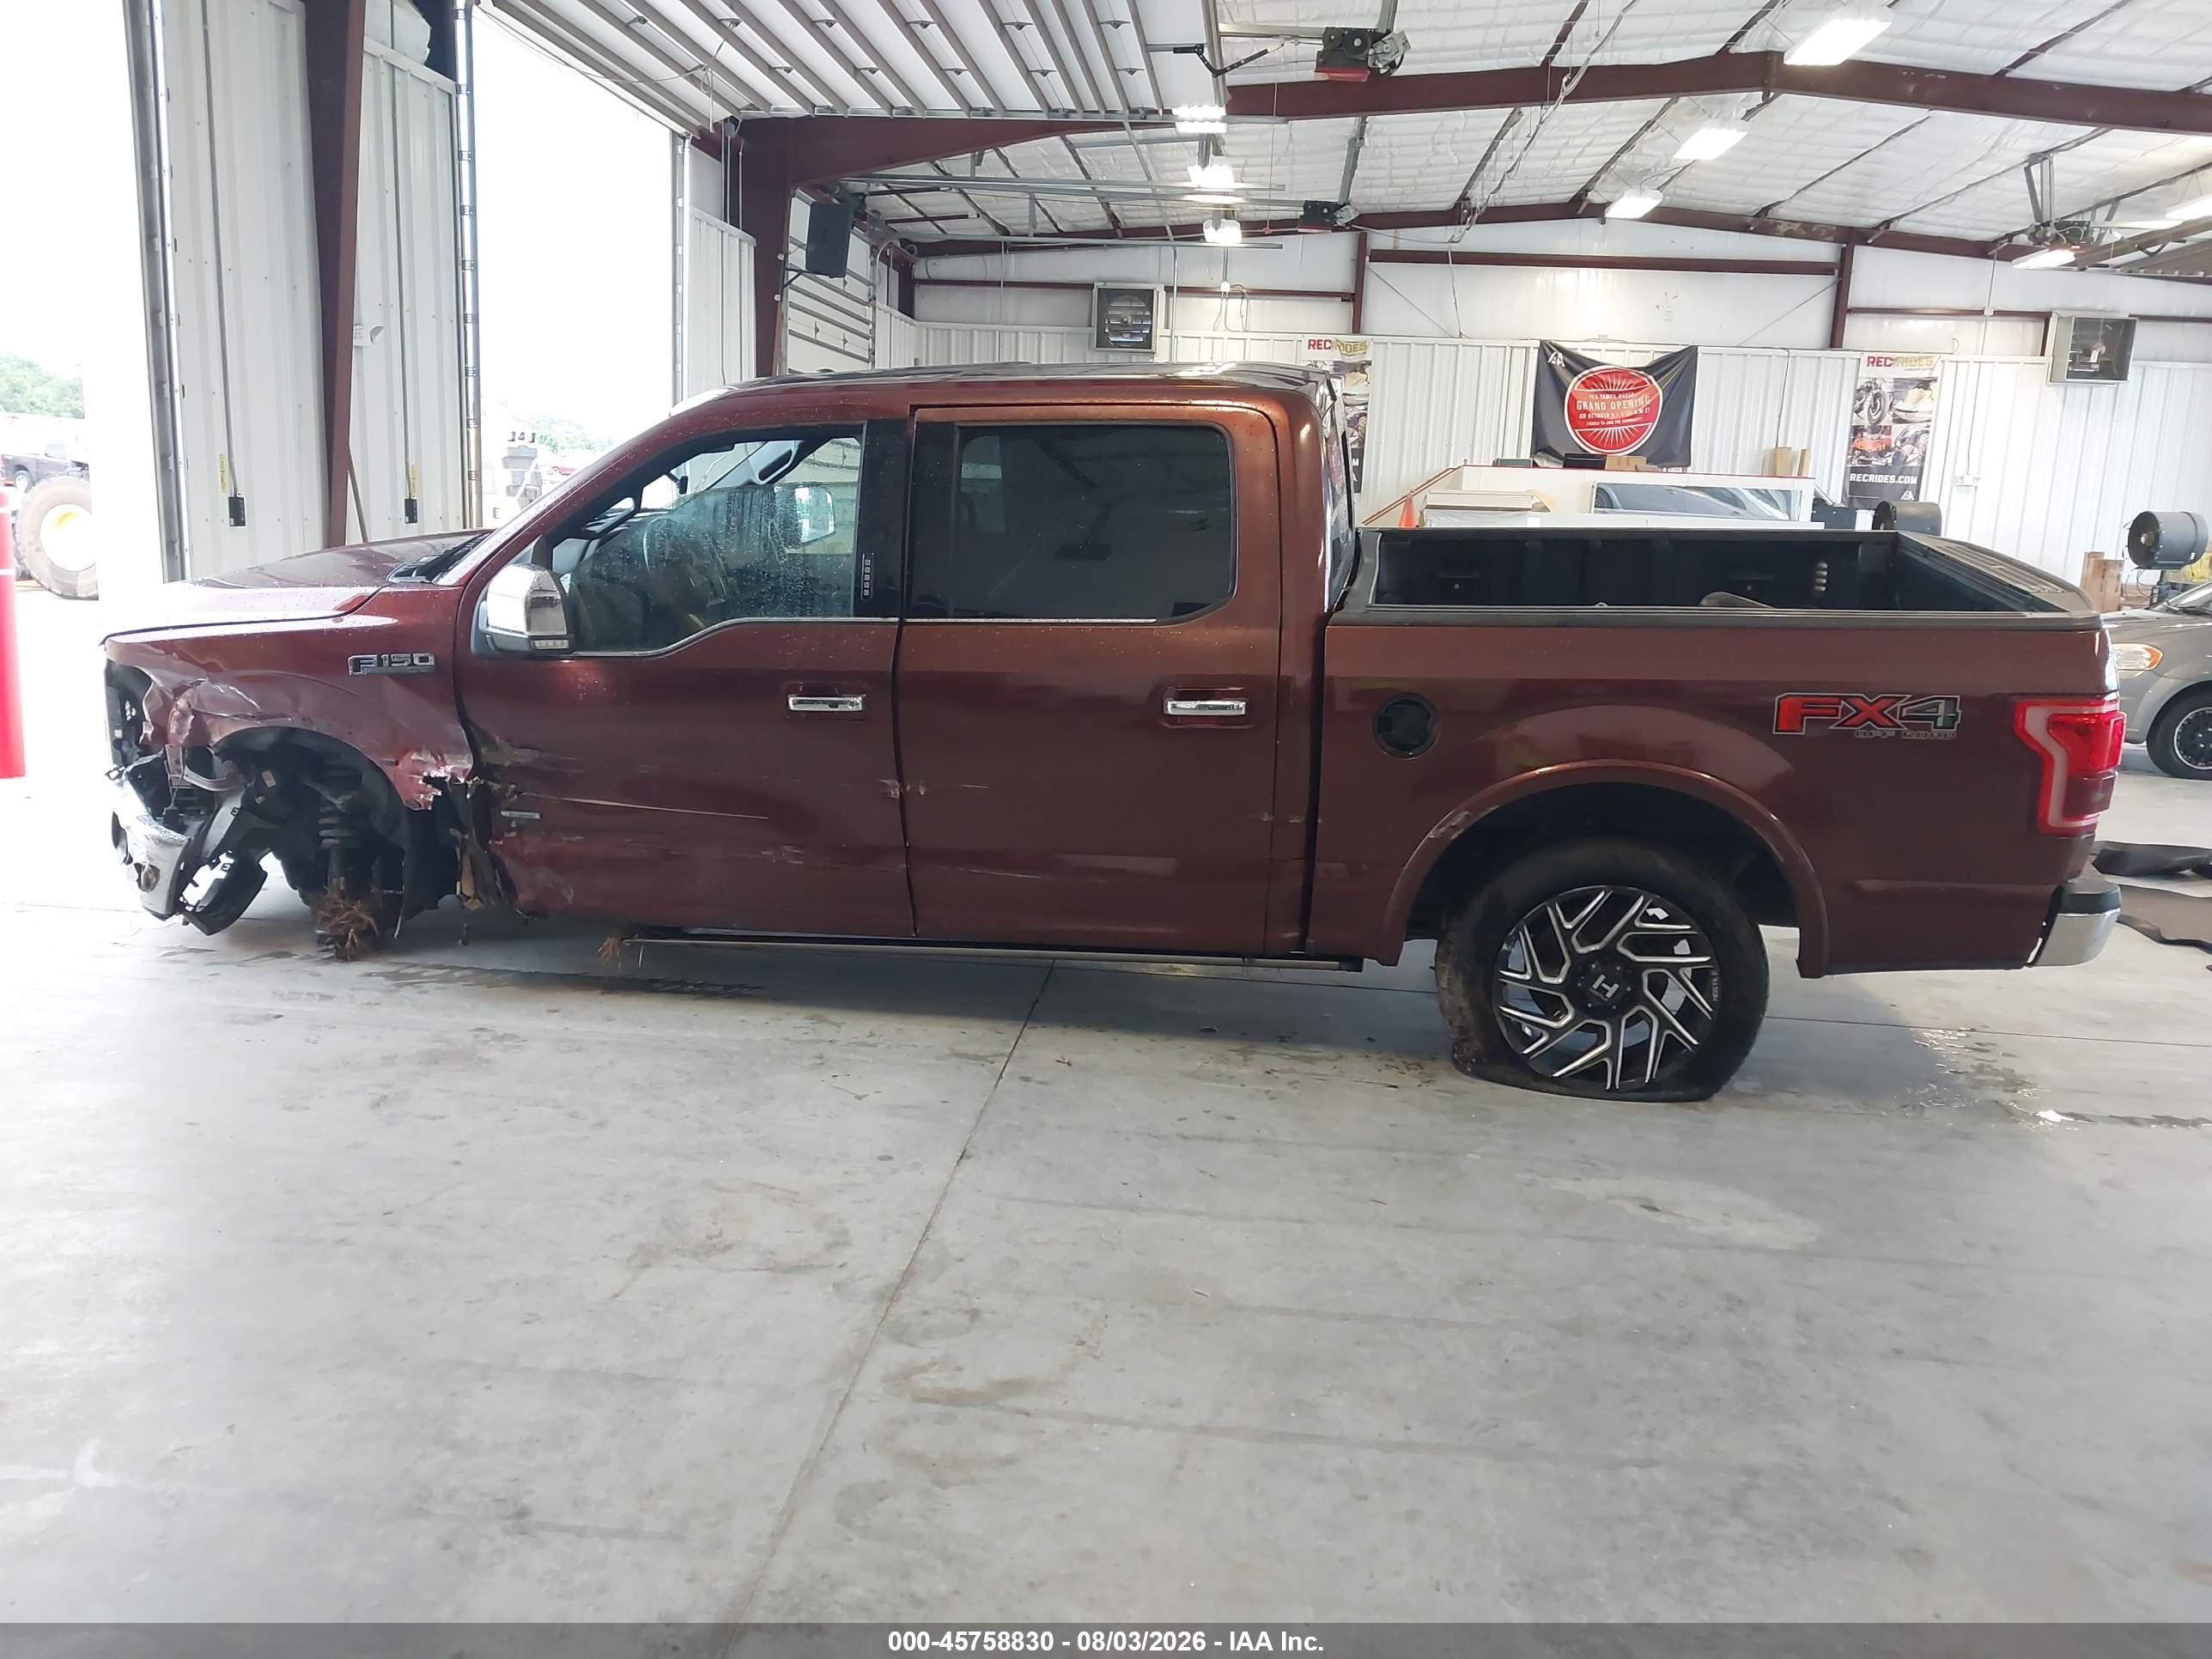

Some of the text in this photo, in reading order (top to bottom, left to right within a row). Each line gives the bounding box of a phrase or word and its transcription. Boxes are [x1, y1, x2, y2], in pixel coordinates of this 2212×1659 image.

[1577, 396, 1651, 411] GRAND OPENING
[1849, 473, 1917, 484] RECRIDES.COM
[1772, 692, 1961, 735] FX4
